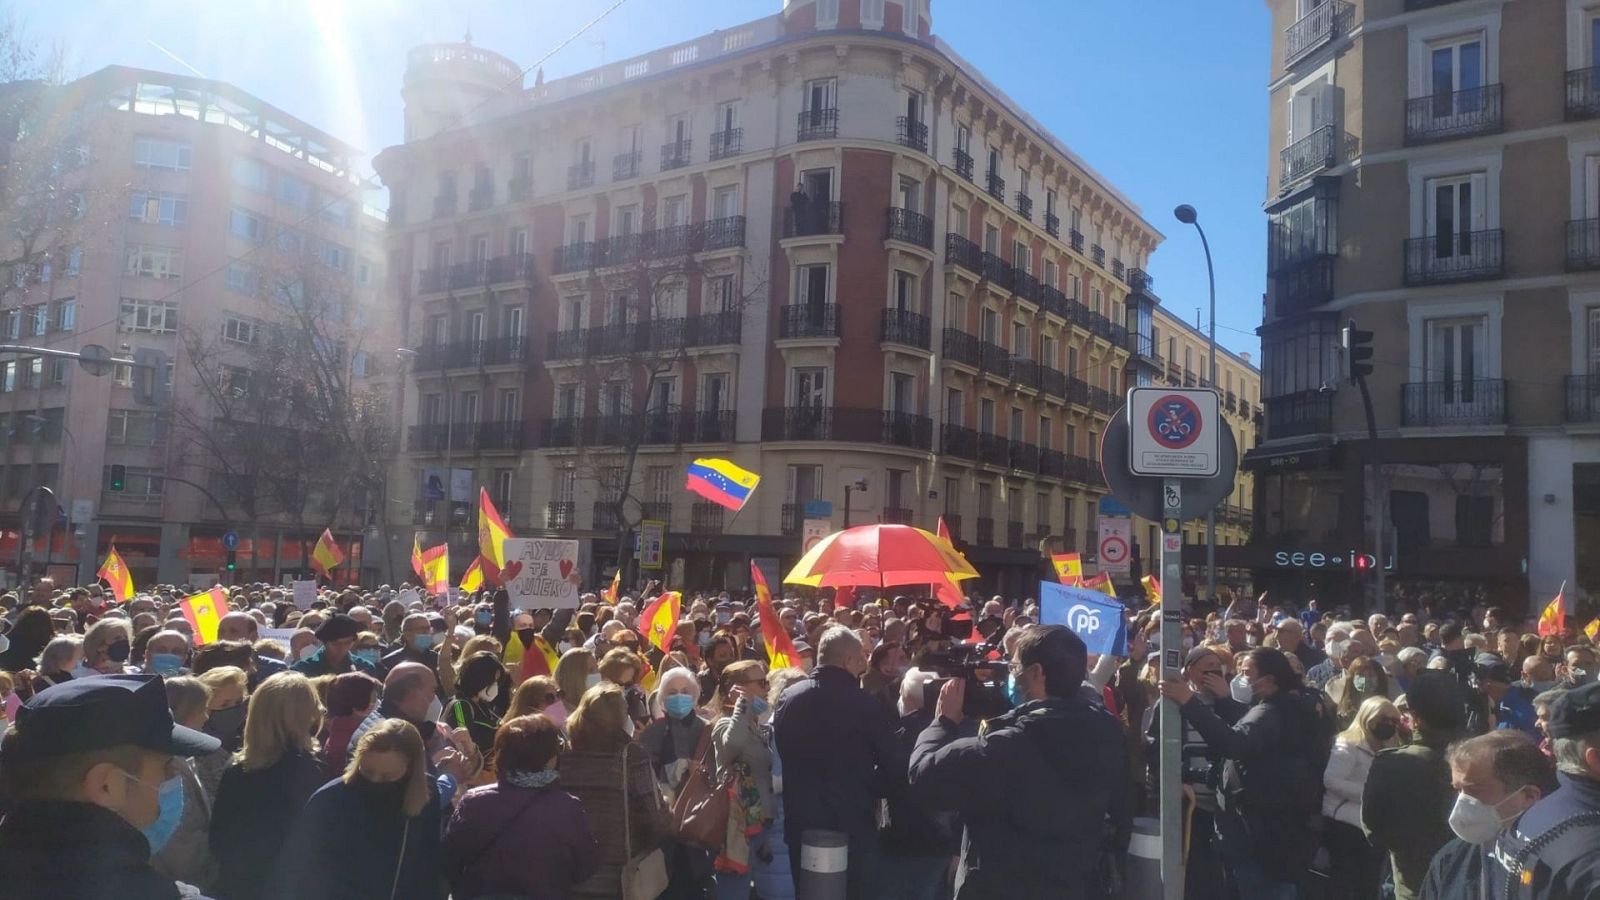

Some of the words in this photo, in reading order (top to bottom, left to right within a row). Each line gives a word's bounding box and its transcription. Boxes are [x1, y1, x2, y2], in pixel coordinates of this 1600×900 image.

[1275, 551, 1326, 567] see
[529, 562, 548, 576] TE
[512, 577, 573, 599] QUIERO
